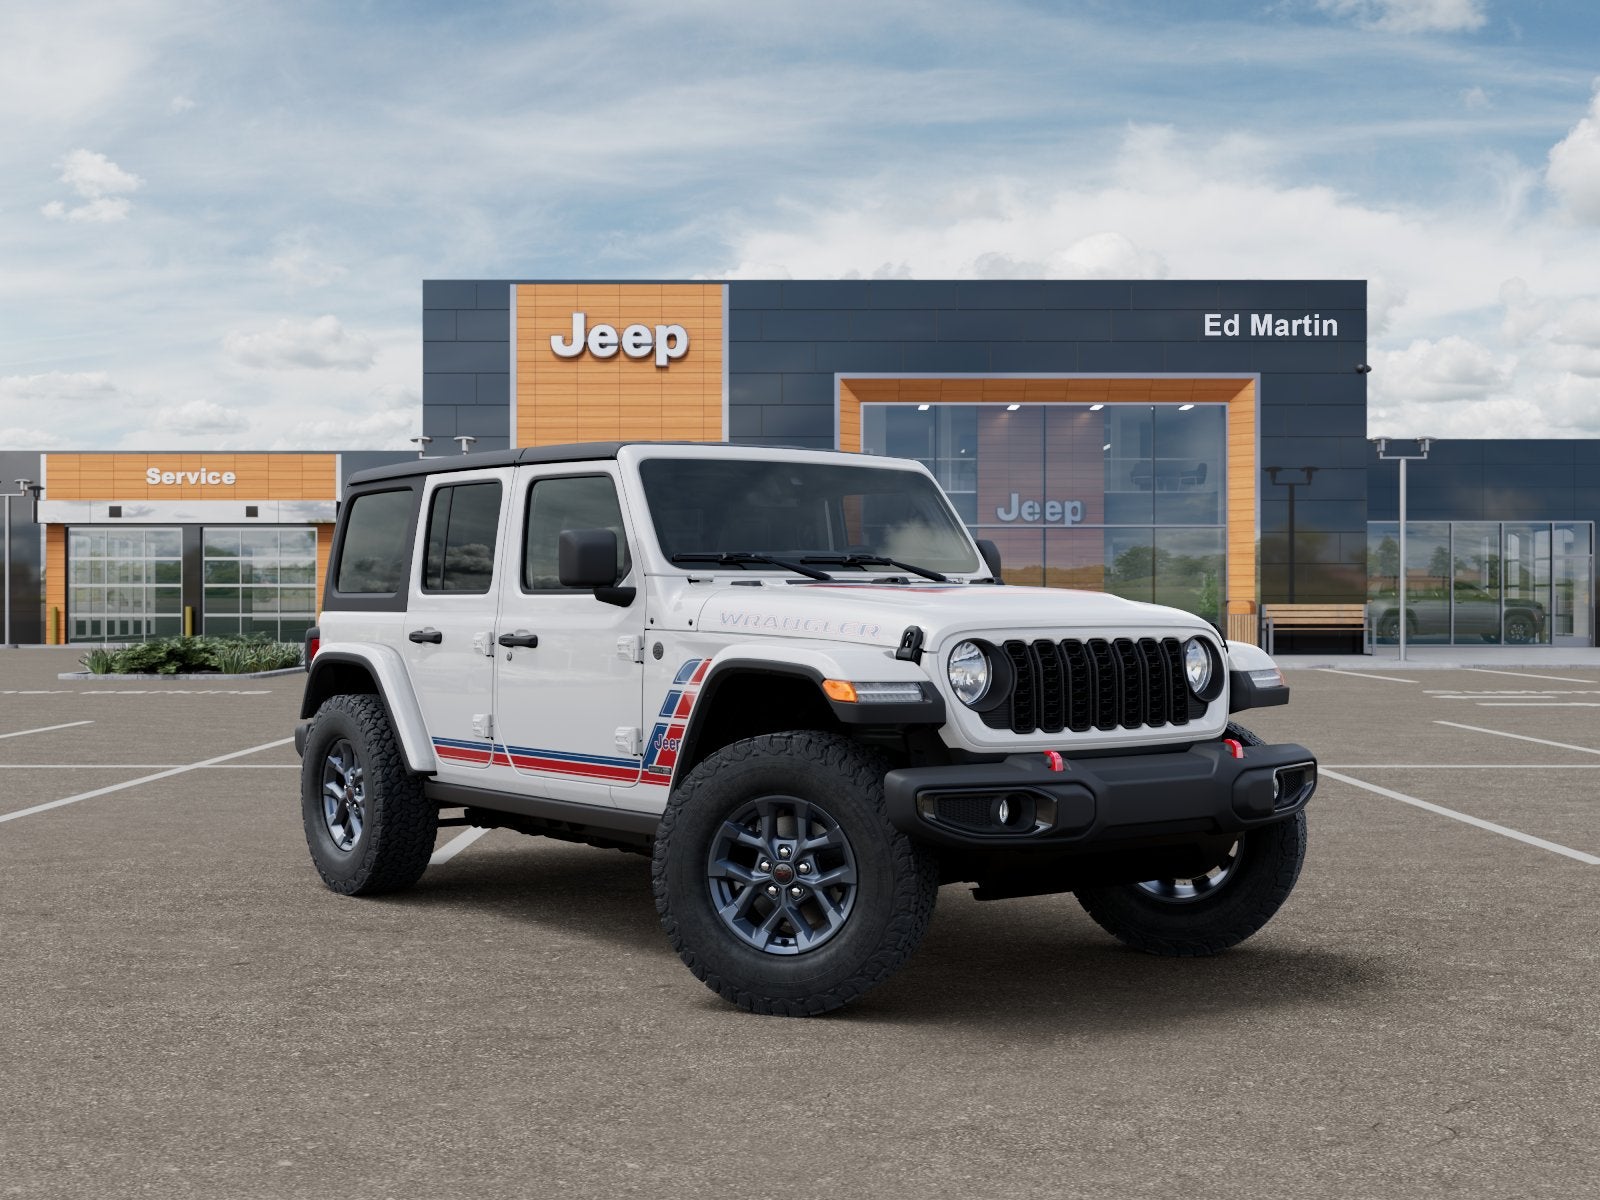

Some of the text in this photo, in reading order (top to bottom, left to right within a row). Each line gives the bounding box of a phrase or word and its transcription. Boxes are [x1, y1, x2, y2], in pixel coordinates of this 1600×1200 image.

[1204, 313, 1338, 337] Ed Martin
[550, 312, 689, 367] Jeep
[146, 467, 236, 485] Service
[996, 492, 1083, 526] Jeep
[720, 610, 881, 638] WRANGLER
